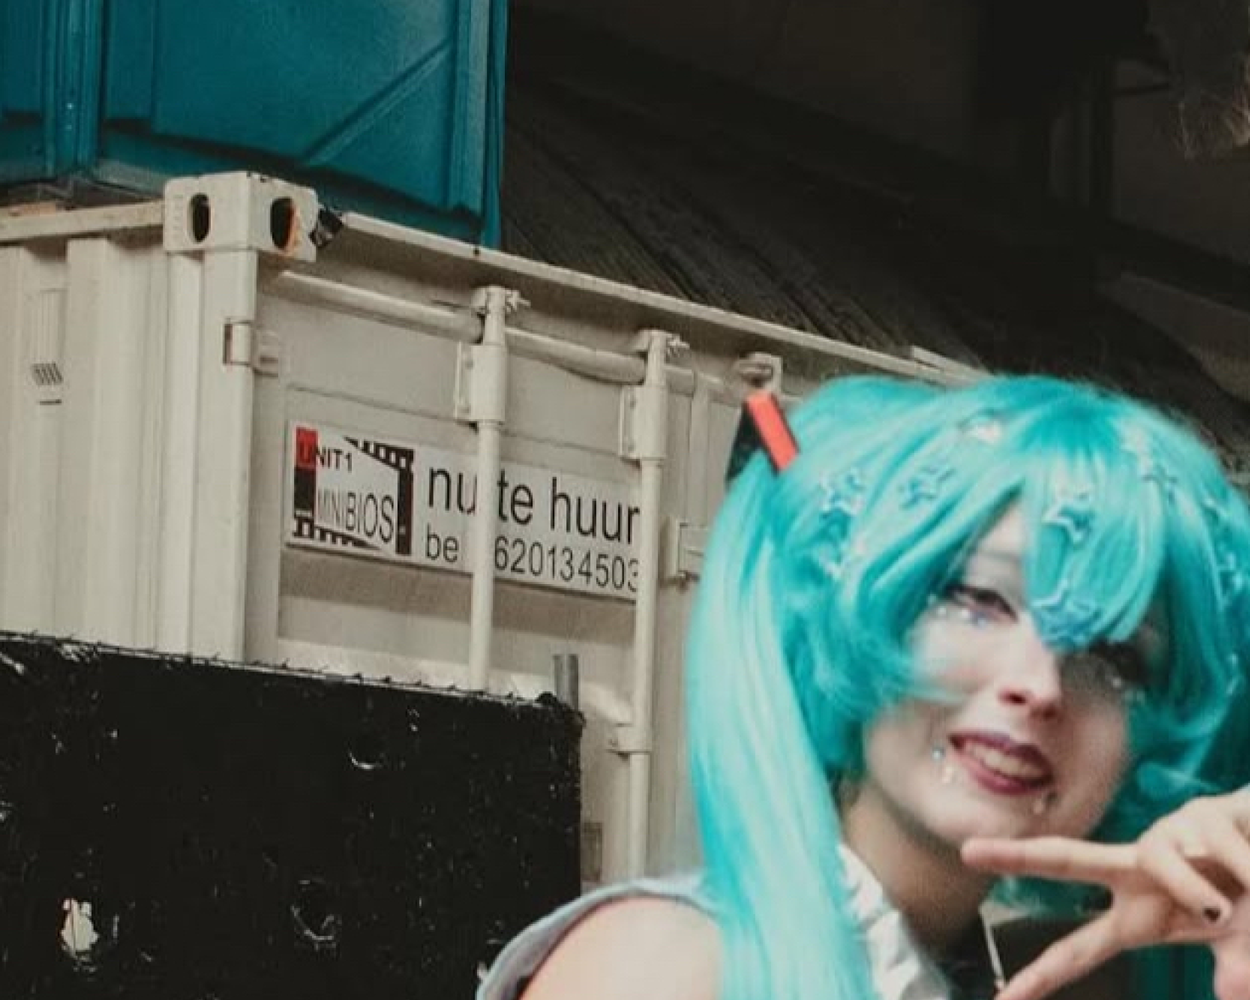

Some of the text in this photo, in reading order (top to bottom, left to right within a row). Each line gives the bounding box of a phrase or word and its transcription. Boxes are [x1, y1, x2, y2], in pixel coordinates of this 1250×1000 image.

[428, 467, 641, 545] nu te huur
[493, 535, 640, 593] 620134503
